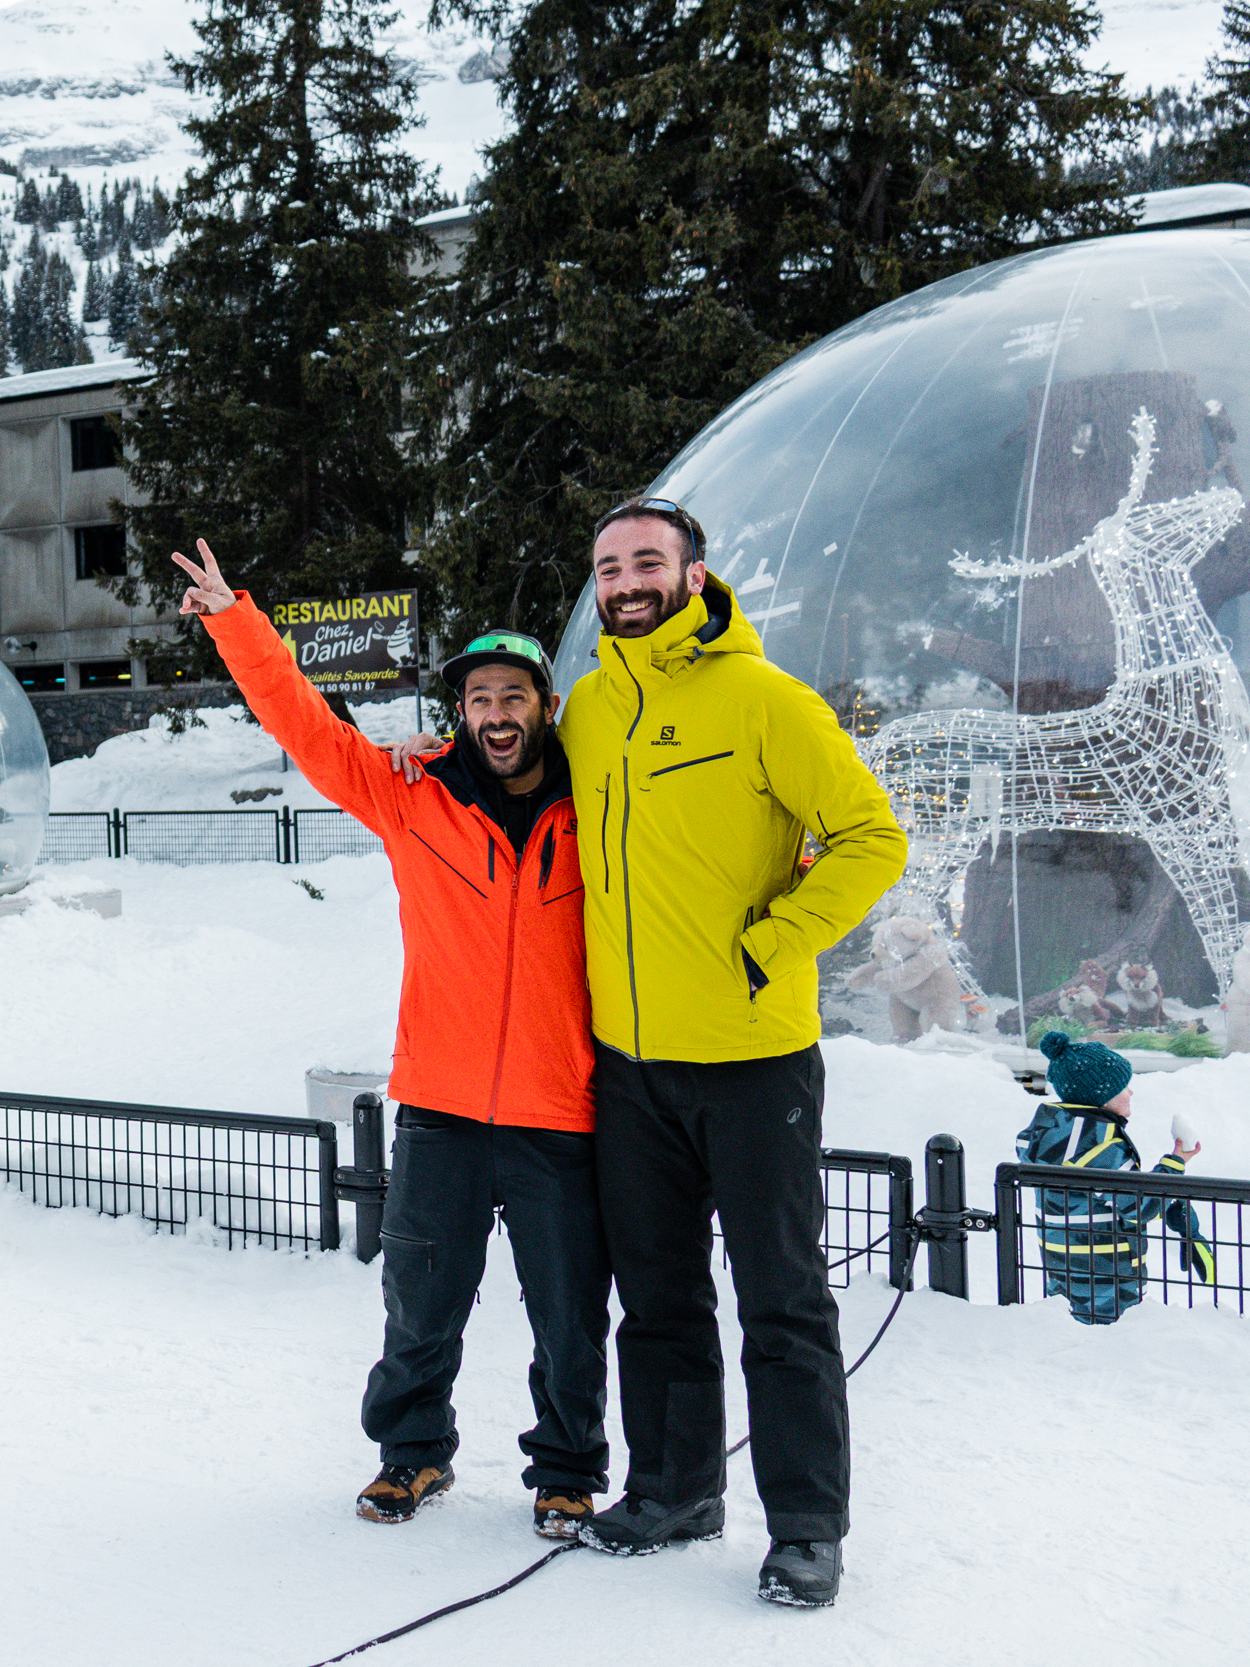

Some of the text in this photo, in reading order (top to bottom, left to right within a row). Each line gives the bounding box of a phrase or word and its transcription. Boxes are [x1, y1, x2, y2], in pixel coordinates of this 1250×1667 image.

[273, 594, 412, 626] RESTAURANT
[315, 624, 350, 642] Chez
[300, 627, 373, 666] Daniel
[306, 668, 400, 682] cialités Savoyardes
[327, 683, 337, 692] 50
[339, 682, 350, 691] 90
[352, 682, 362, 691] 81
[364, 681, 375, 690] 87
